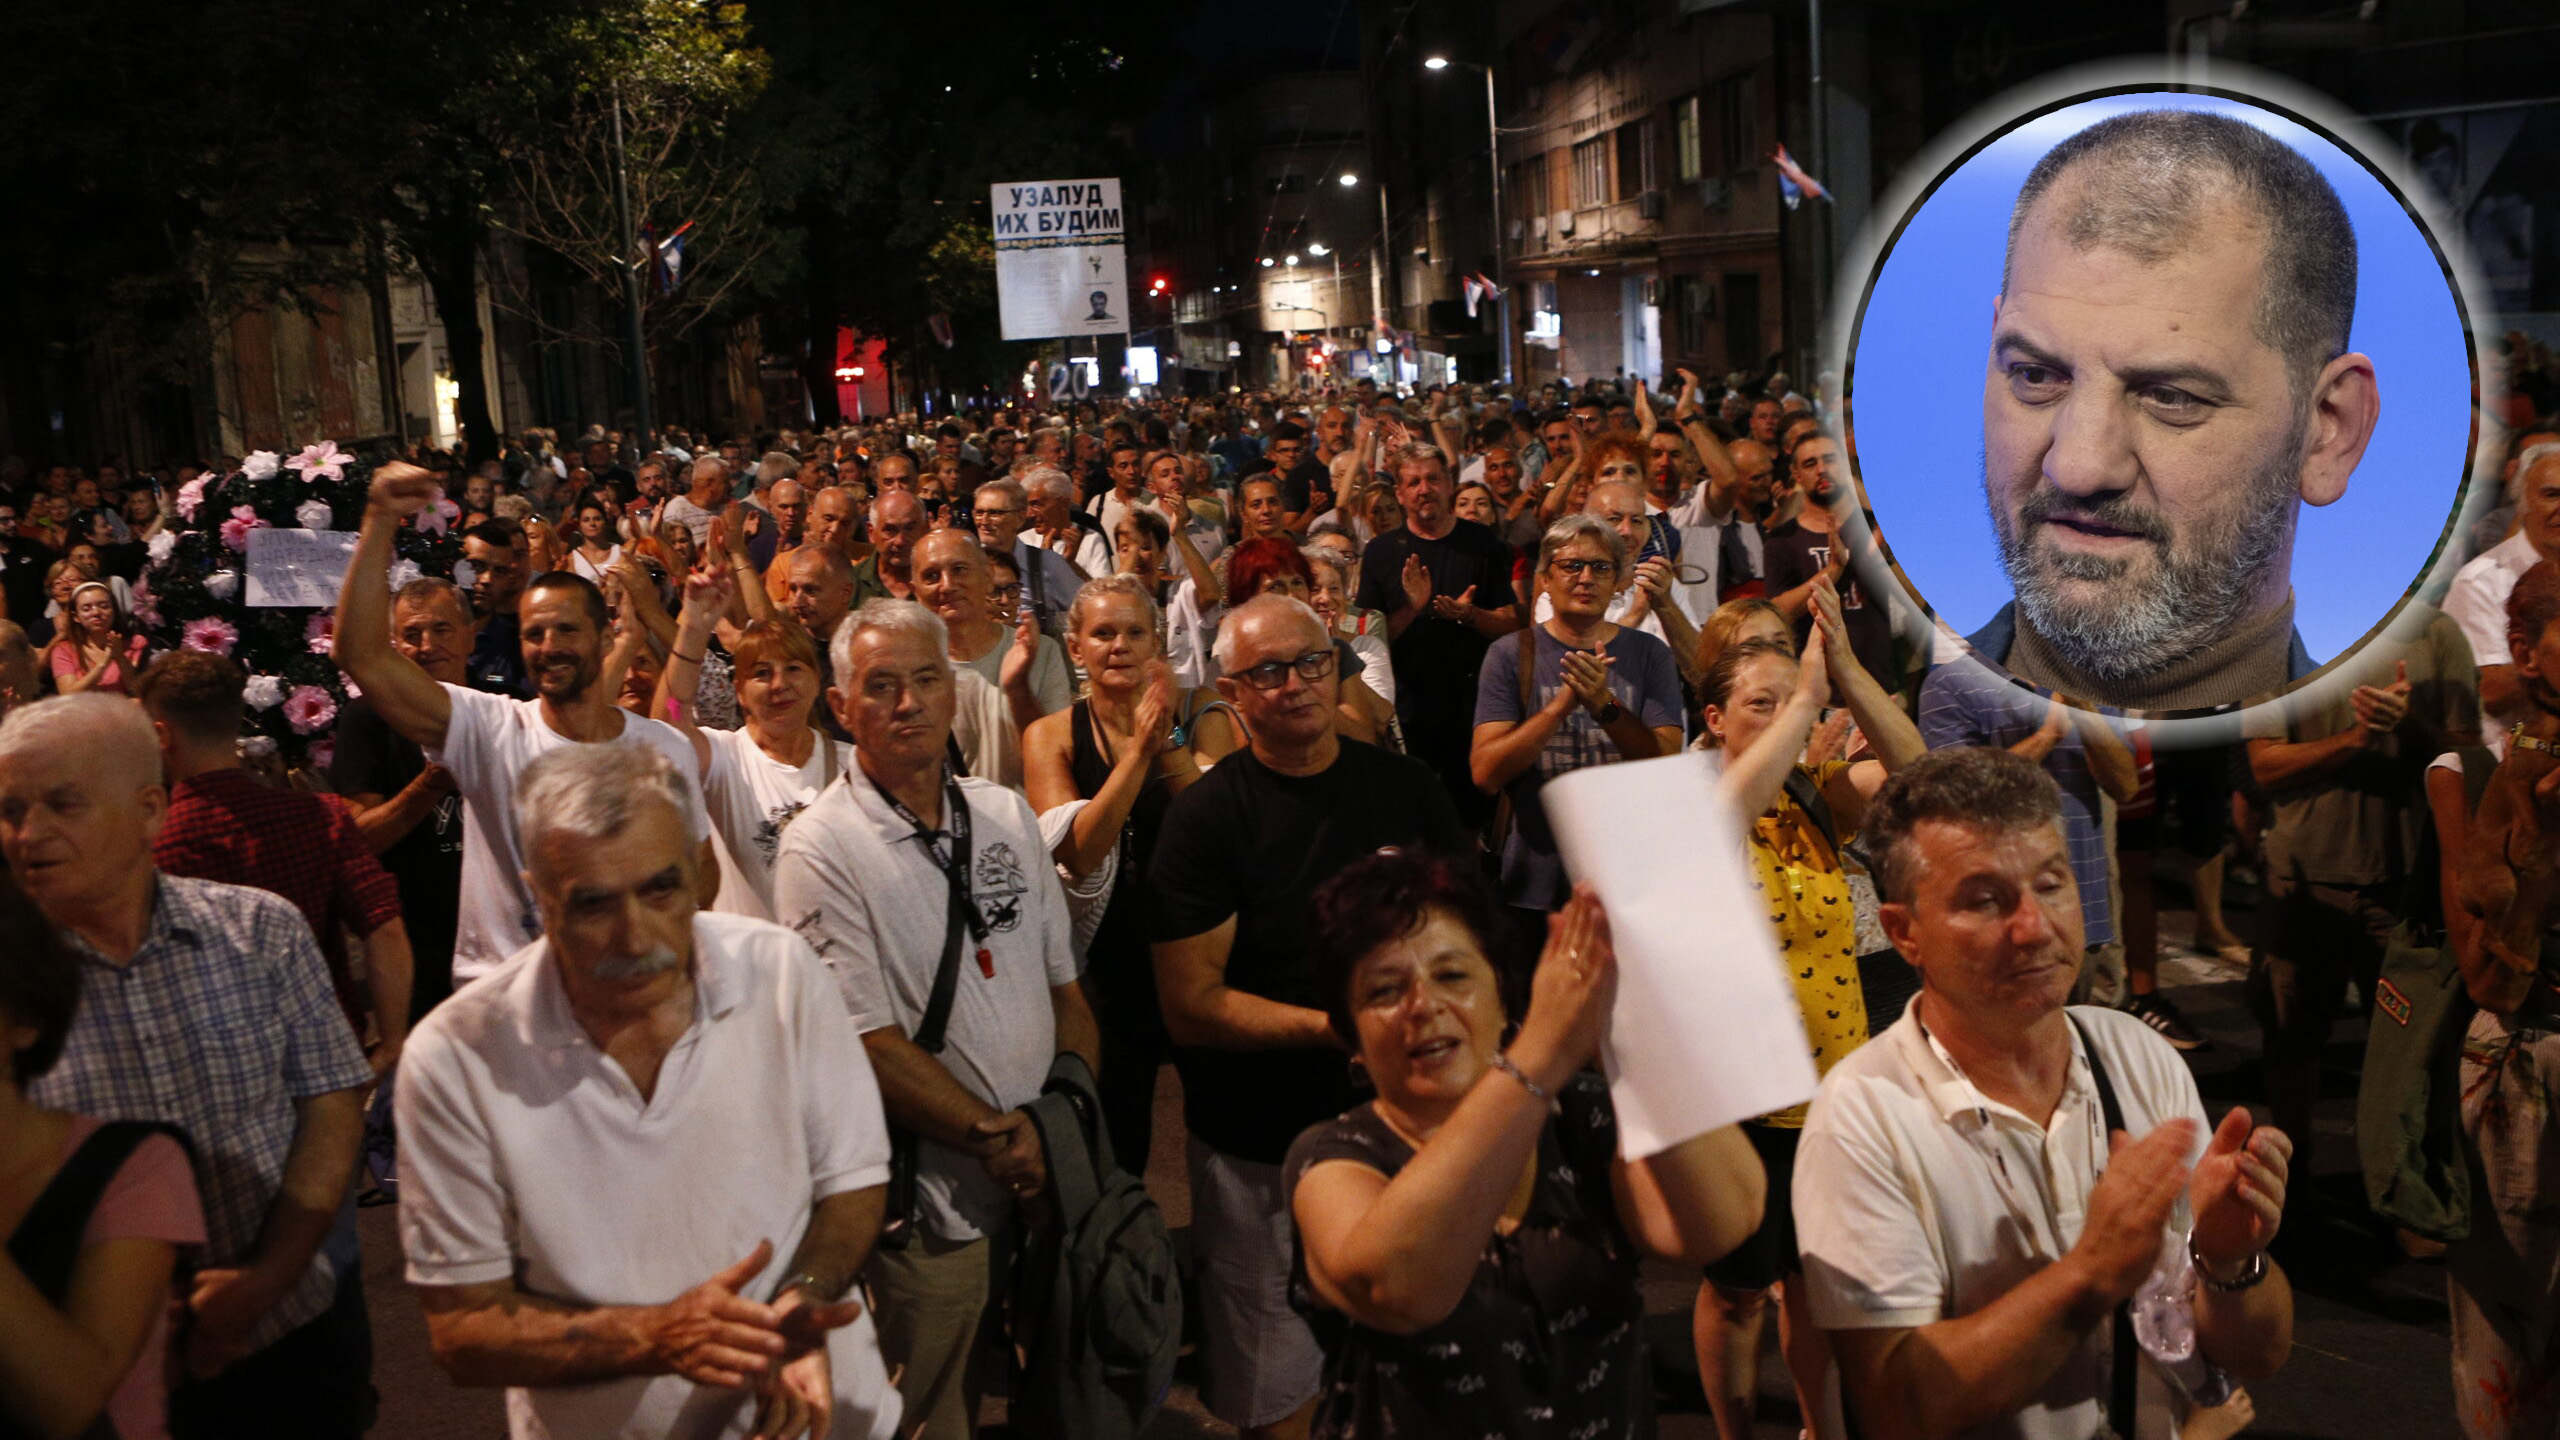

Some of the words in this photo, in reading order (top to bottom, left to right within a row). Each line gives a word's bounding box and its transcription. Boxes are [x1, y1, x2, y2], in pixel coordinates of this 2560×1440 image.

[1010, 184, 1103, 209] УЗАЛУД
[996, 212, 1029, 234] ИХ
[1038, 208, 1120, 234] БУДИМ
